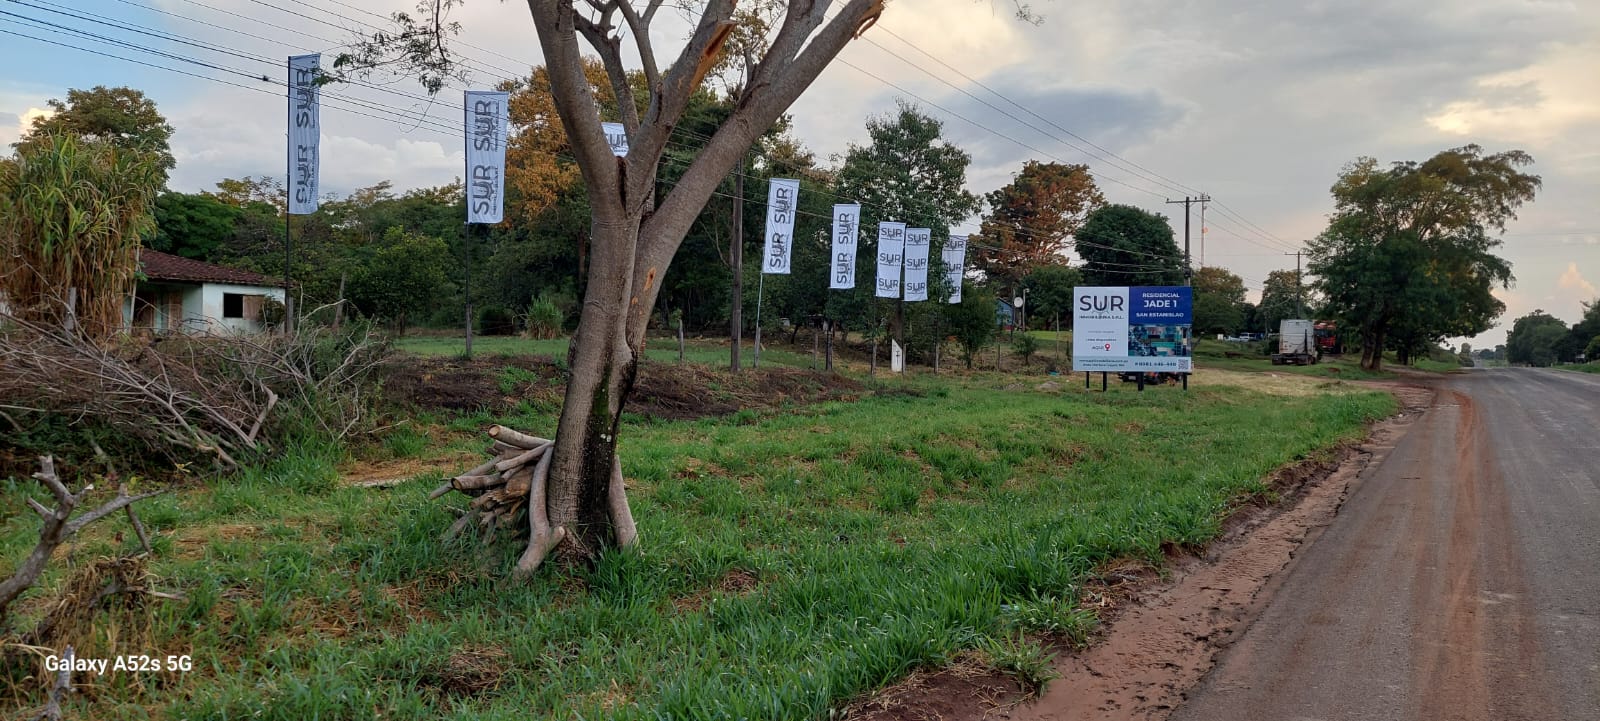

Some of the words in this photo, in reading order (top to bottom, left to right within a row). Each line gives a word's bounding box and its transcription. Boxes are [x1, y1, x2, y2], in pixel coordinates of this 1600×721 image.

[296, 69, 311, 128] SUR
[474, 99, 492, 152] SUR
[296, 144, 310, 204] SUR
[473, 164, 491, 215] SUR
[774, 187, 788, 224] SUR
[838, 213, 850, 244] SUR
[881, 227, 902, 237] SUR
[907, 233, 928, 242] SUR
[770, 233, 784, 268] SUR
[879, 253, 901, 263] SUR
[906, 258, 927, 267] SUR
[837, 252, 848, 284] SUR
[878, 278, 899, 288] SUR
[906, 282, 925, 291] SUR
[1079, 295, 1124, 312] SUR
[1143, 300, 1171, 308] JADE
[1173, 300, 1177, 308] 1
